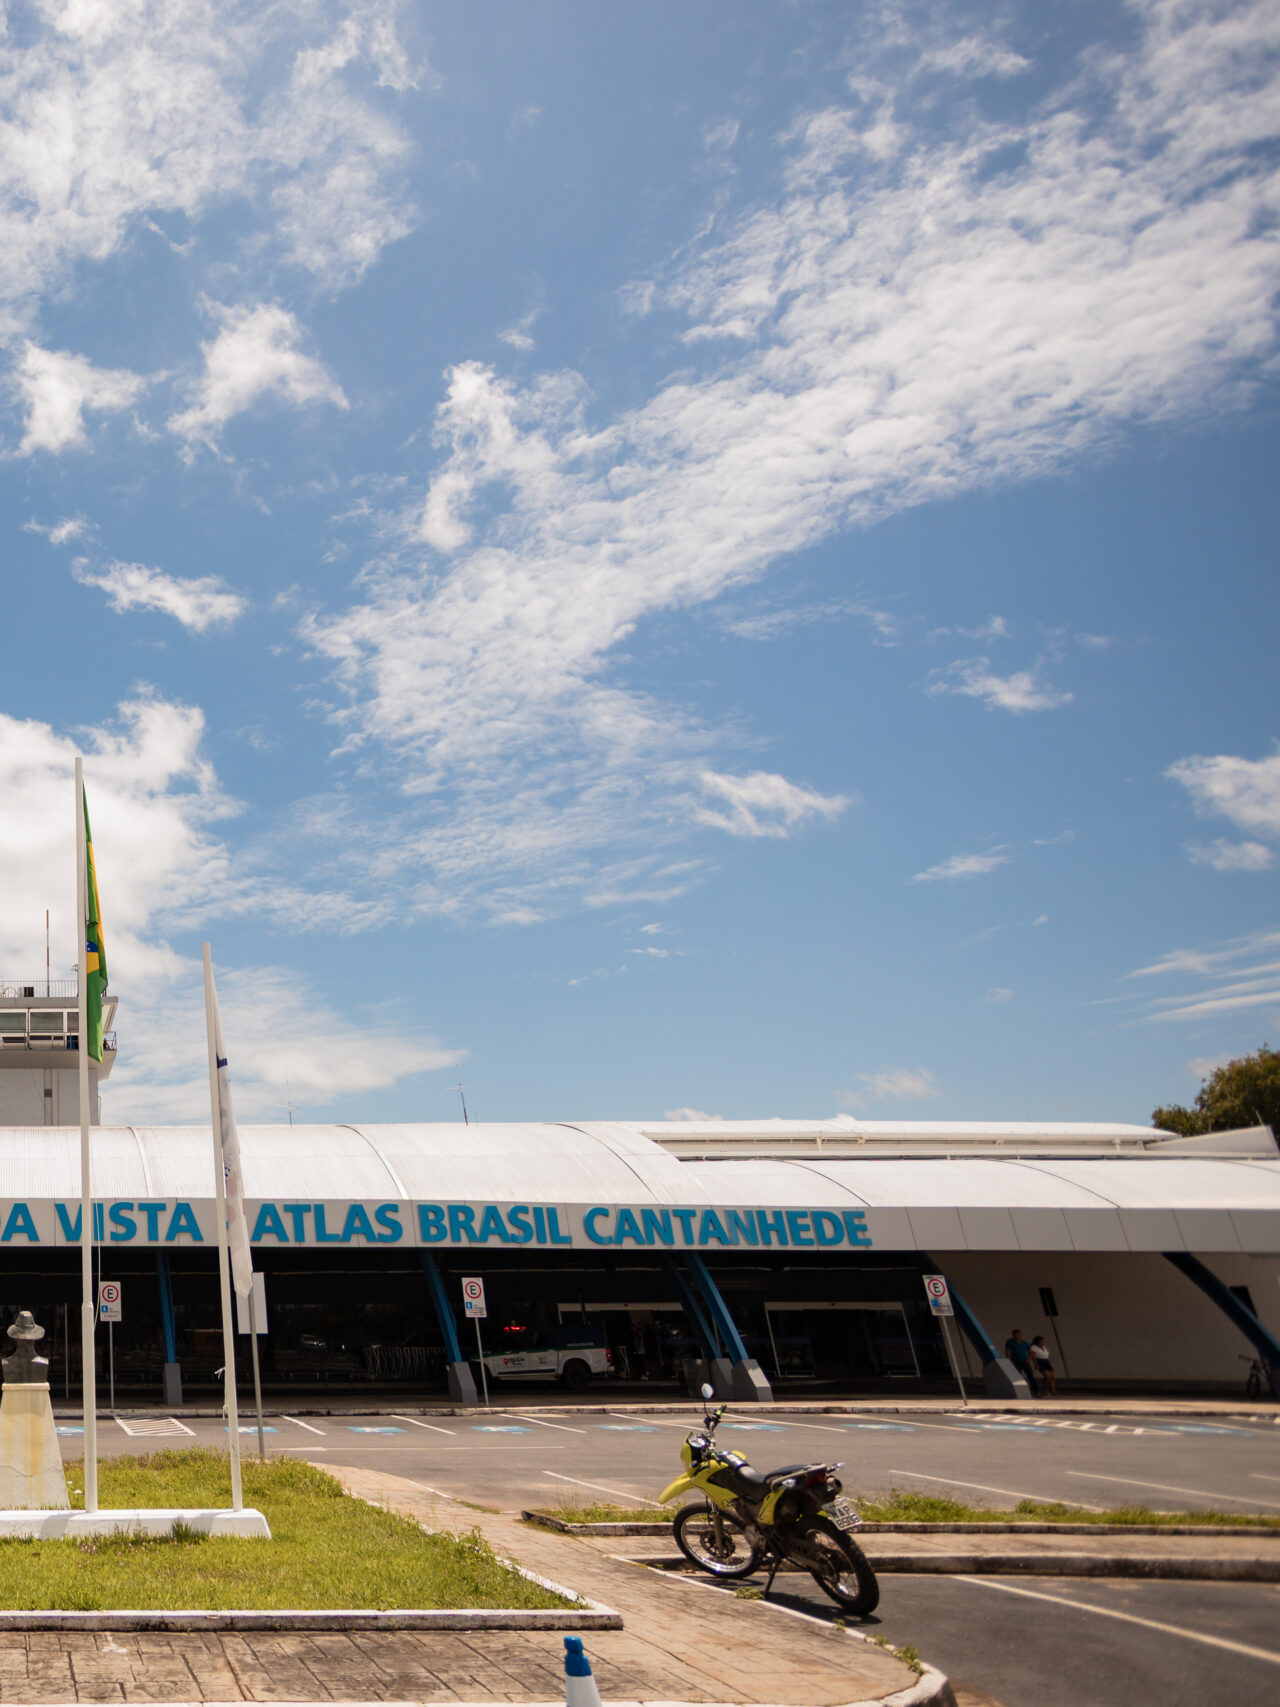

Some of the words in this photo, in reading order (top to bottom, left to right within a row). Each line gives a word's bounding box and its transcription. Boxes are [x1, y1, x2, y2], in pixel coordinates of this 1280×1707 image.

[54, 1202, 204, 1242] VISTA
[251, 1203, 404, 1244] ATLAS
[417, 1204, 573, 1244] BRASIL
[583, 1206, 873, 1246] CANTANHEDE
[469, 1284, 477, 1295] E
[932, 1282, 941, 1293] E
[107, 1288, 114, 1299] E
